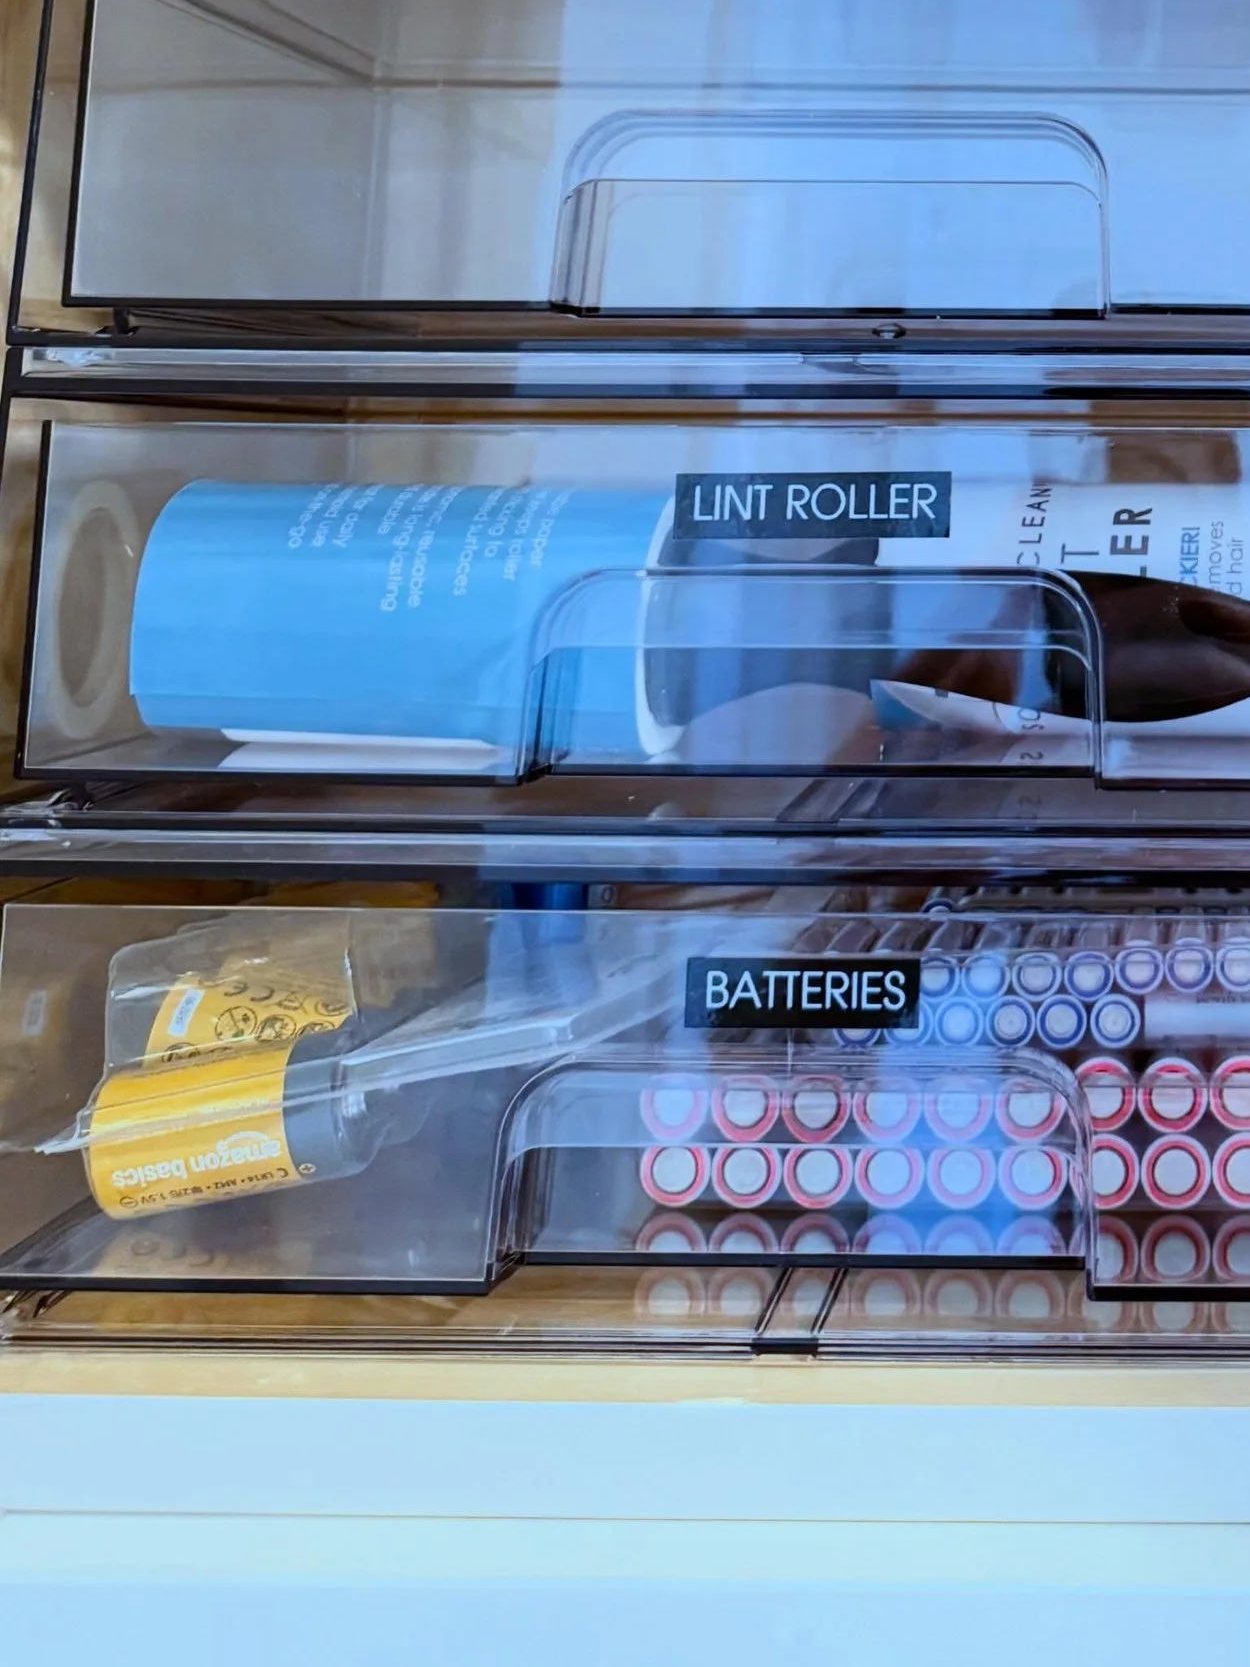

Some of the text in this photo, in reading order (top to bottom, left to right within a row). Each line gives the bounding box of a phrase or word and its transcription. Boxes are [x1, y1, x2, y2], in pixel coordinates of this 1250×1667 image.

[693, 483, 938, 521] LINT ROLLER
[380, 513, 424, 612] long-lasting
[406, 529, 437, 609] reusable
[453, 523, 483, 597] surfaces
[705, 969, 907, 1011] BATTERIES
[112, 1138, 282, 1189] amazon basics
